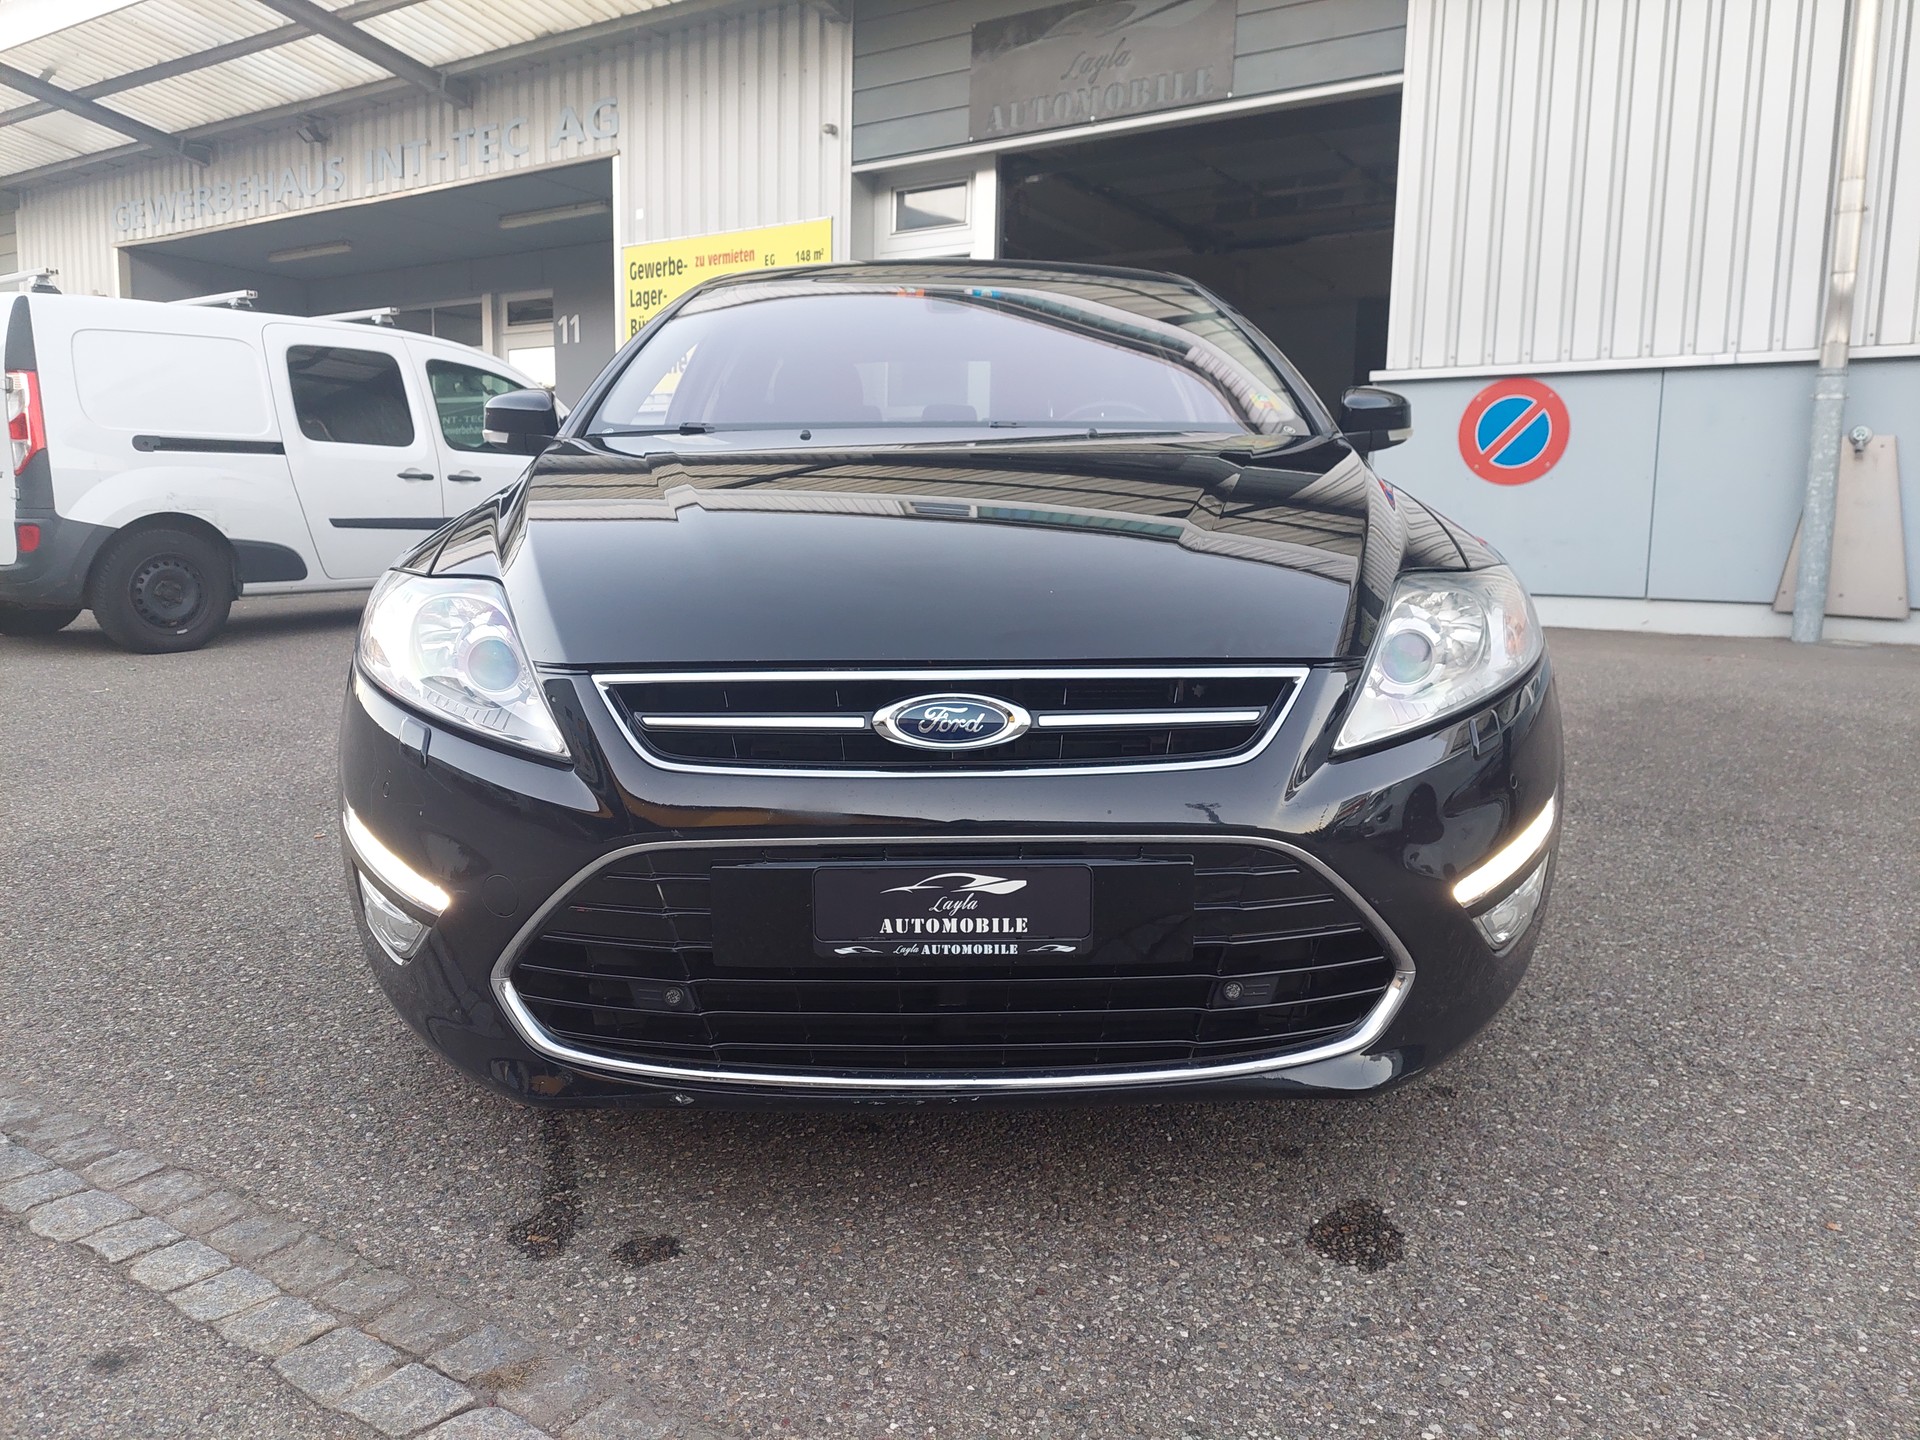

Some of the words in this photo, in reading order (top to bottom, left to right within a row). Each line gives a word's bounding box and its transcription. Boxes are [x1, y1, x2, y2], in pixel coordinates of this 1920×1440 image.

[1060, 37, 1132, 85] Layla
[986, 64, 1214, 132] AUTOMOBILE
[112, 156, 345, 232] GEWERBEHAUS
[551, 97, 620, 149] AG
[629, 256, 688, 281] Gewerbe-
[695, 254, 705, 268] zu
[707, 248, 756, 266] vermieten
[795, 249, 811, 263] 148
[629, 288, 668, 311] Lager-
[557, 313, 581, 345] 11
[917, 706, 986, 734] Ford
[928, 892, 979, 917] Layla
[879, 917, 1029, 934] AUTOMOBILE
[892, 943, 920, 956] Layla
[920, 944, 1019, 955] AUTOMOBILE
